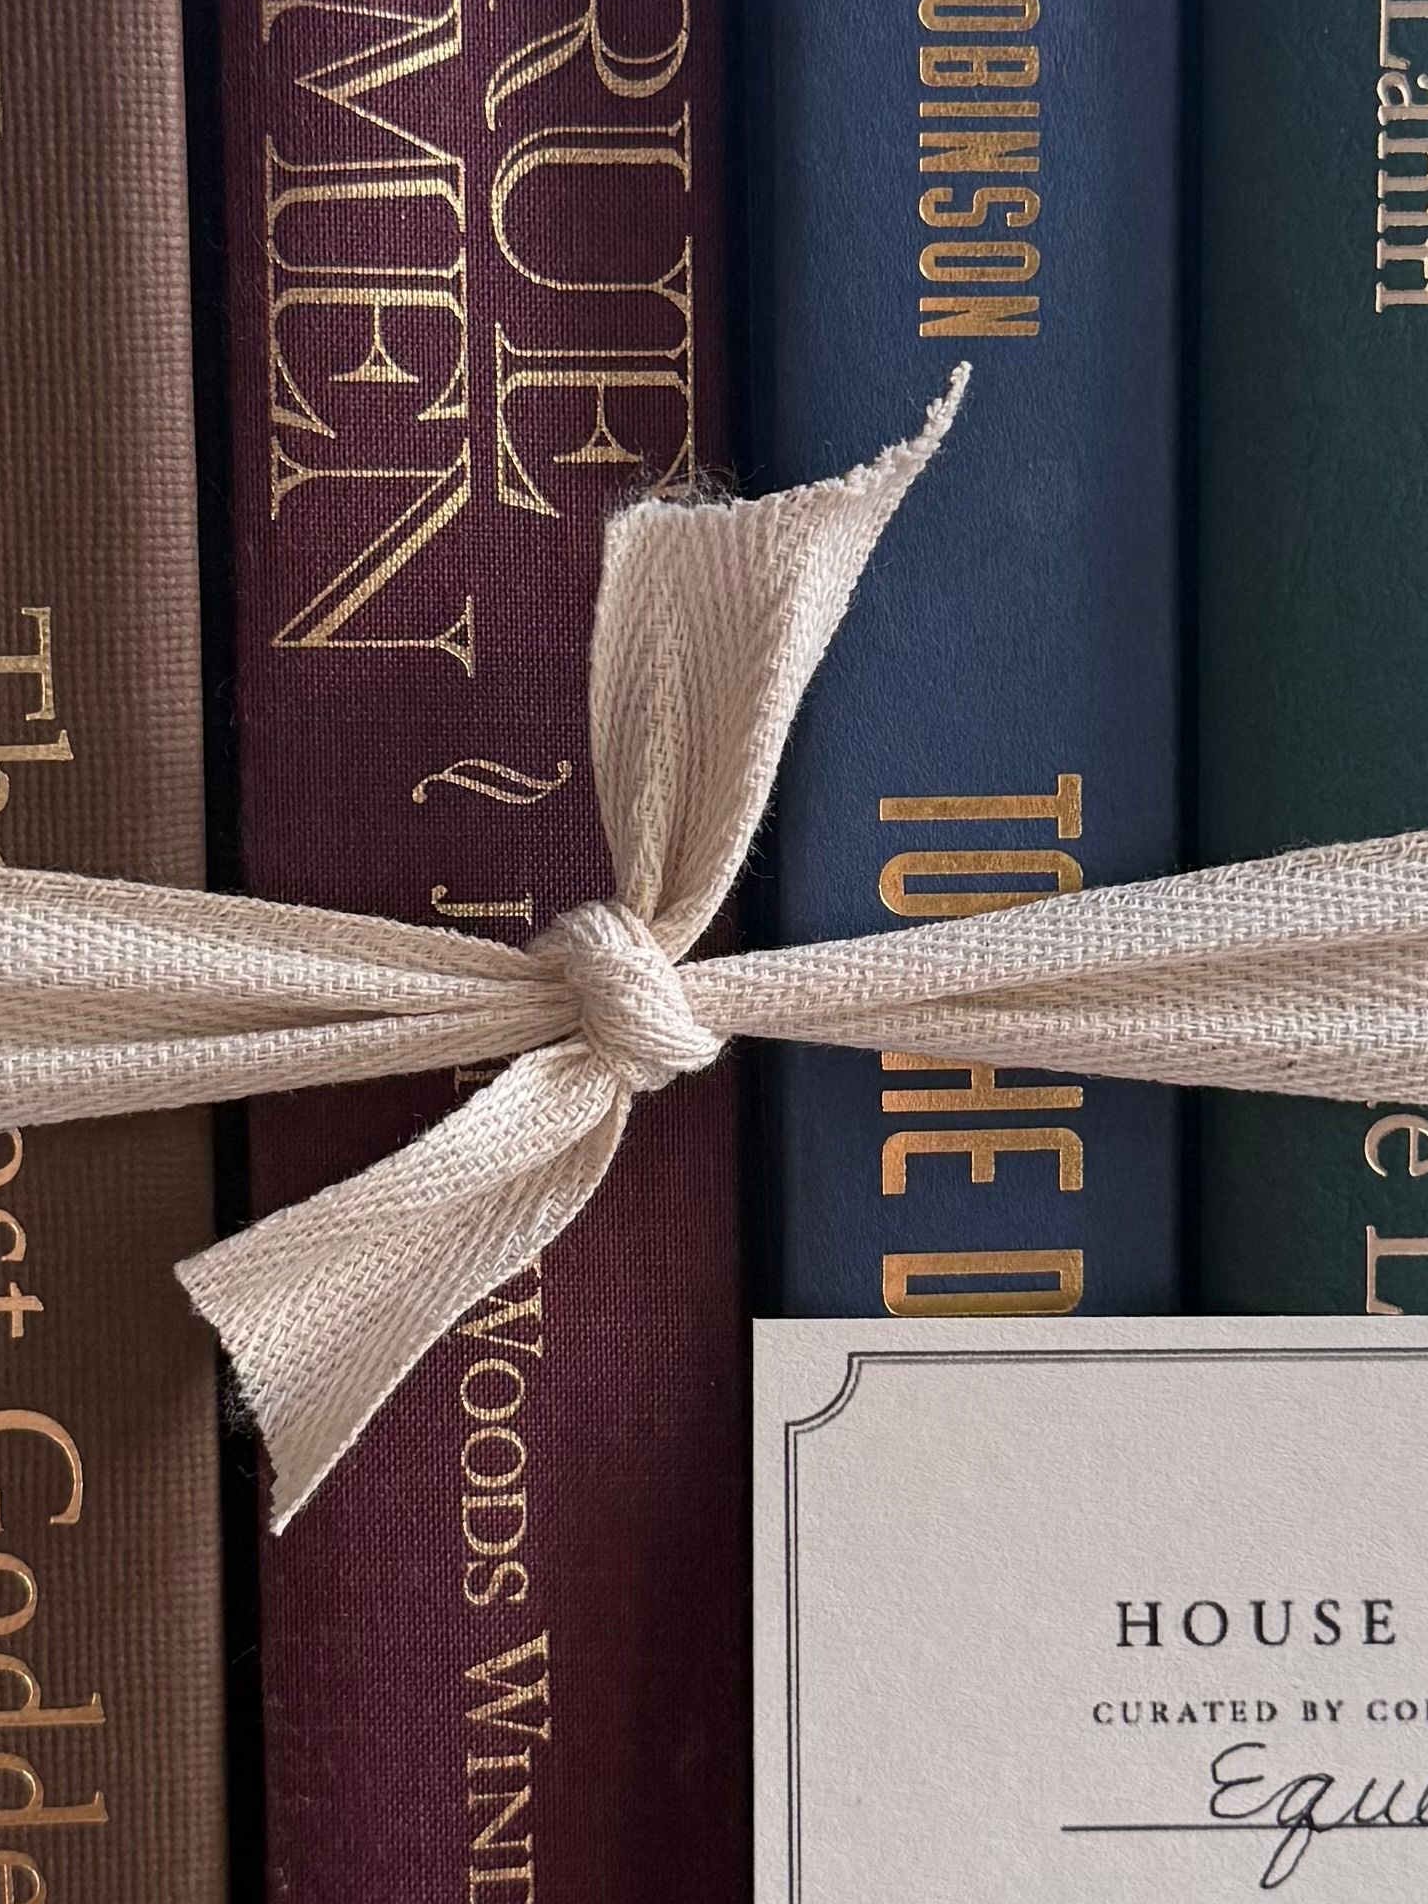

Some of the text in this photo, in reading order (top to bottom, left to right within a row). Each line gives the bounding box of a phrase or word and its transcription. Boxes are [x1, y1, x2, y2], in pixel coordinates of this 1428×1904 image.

[877, 773, 1083, 916] TO
[879, 1050, 1084, 1195] HE
[1115, 1598, 1397, 1649] HOUSE
[1091, 1699, 1279, 1725] CURATED
[1301, 1698, 1344, 1724] BY
